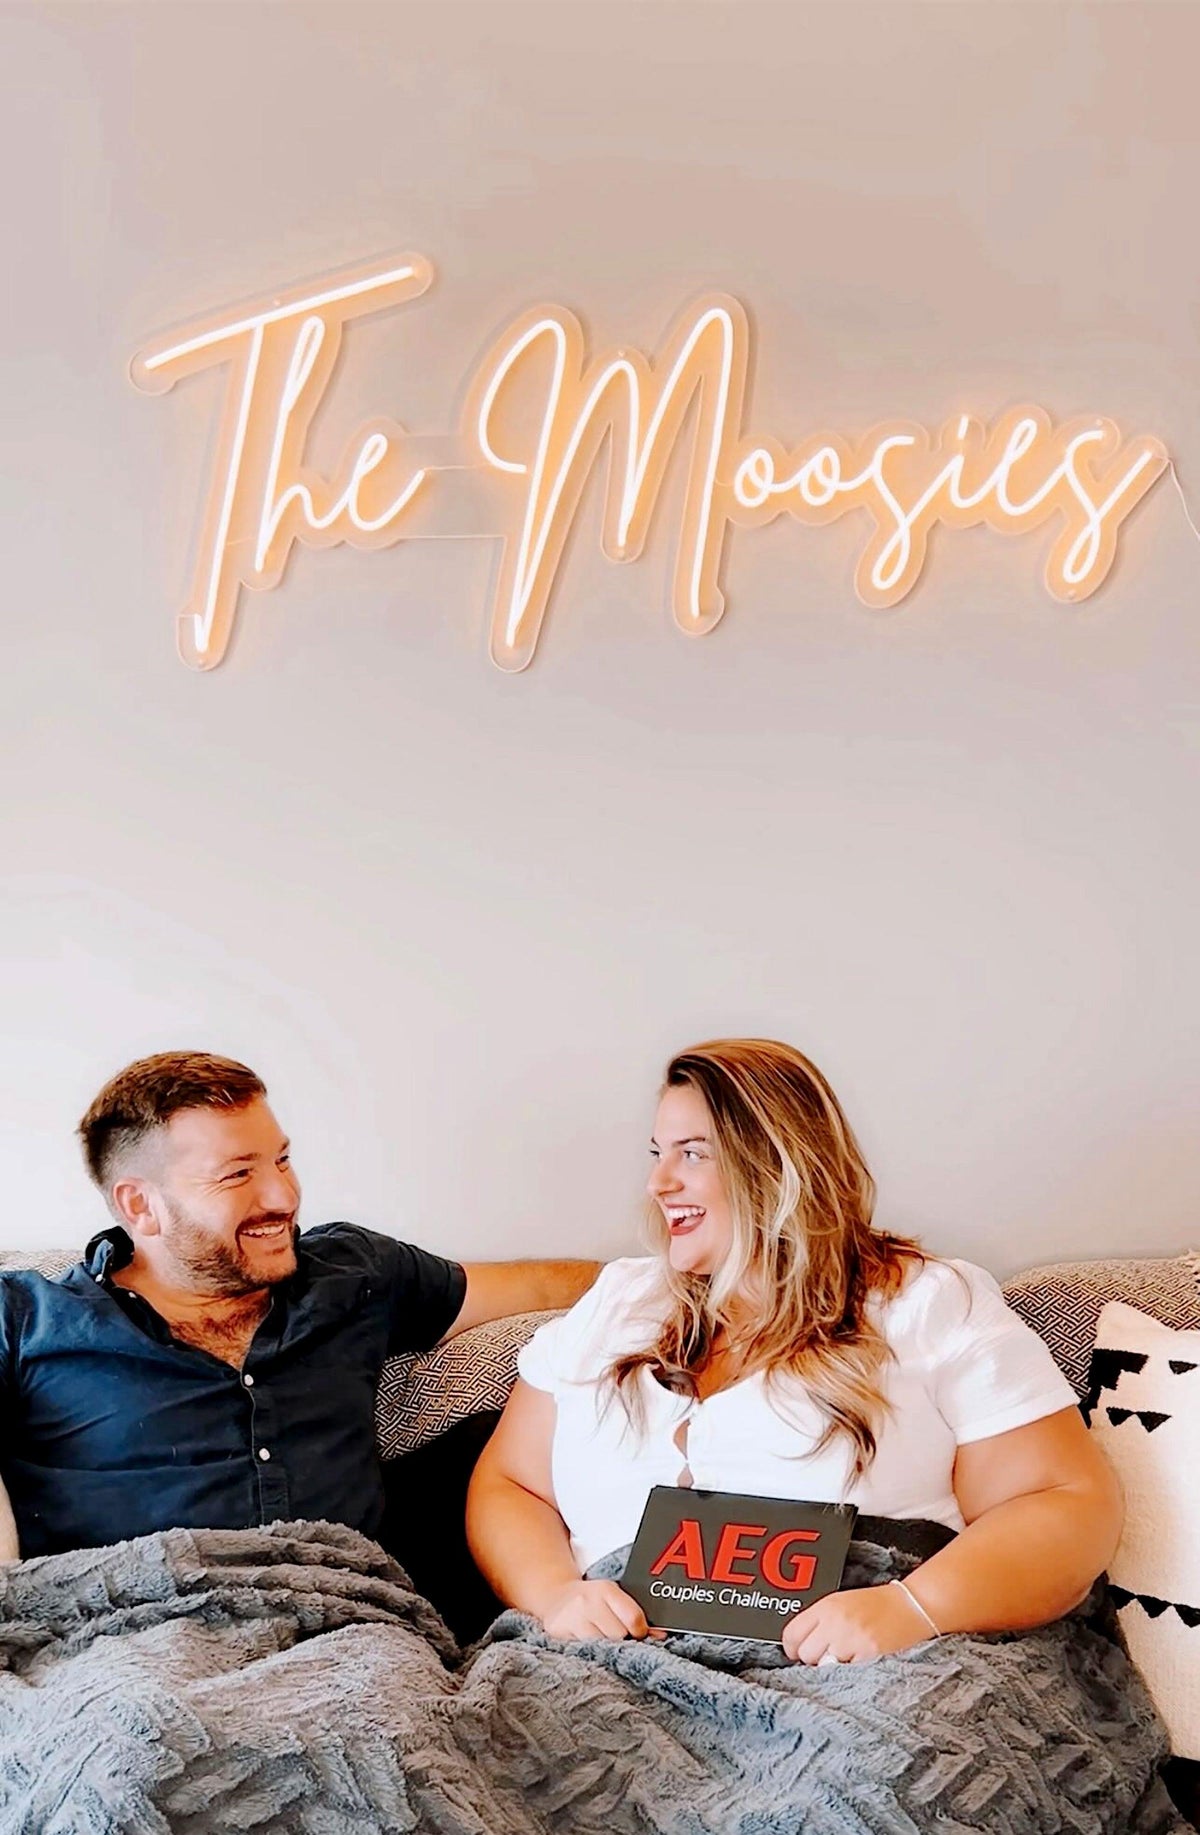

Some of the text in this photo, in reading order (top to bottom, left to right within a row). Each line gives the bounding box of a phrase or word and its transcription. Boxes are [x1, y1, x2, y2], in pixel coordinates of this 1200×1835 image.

[144, 266, 1153, 652] The Moosies
[651, 1519, 821, 1591] AEG
[650, 1580, 802, 1616] Couples Challenge
